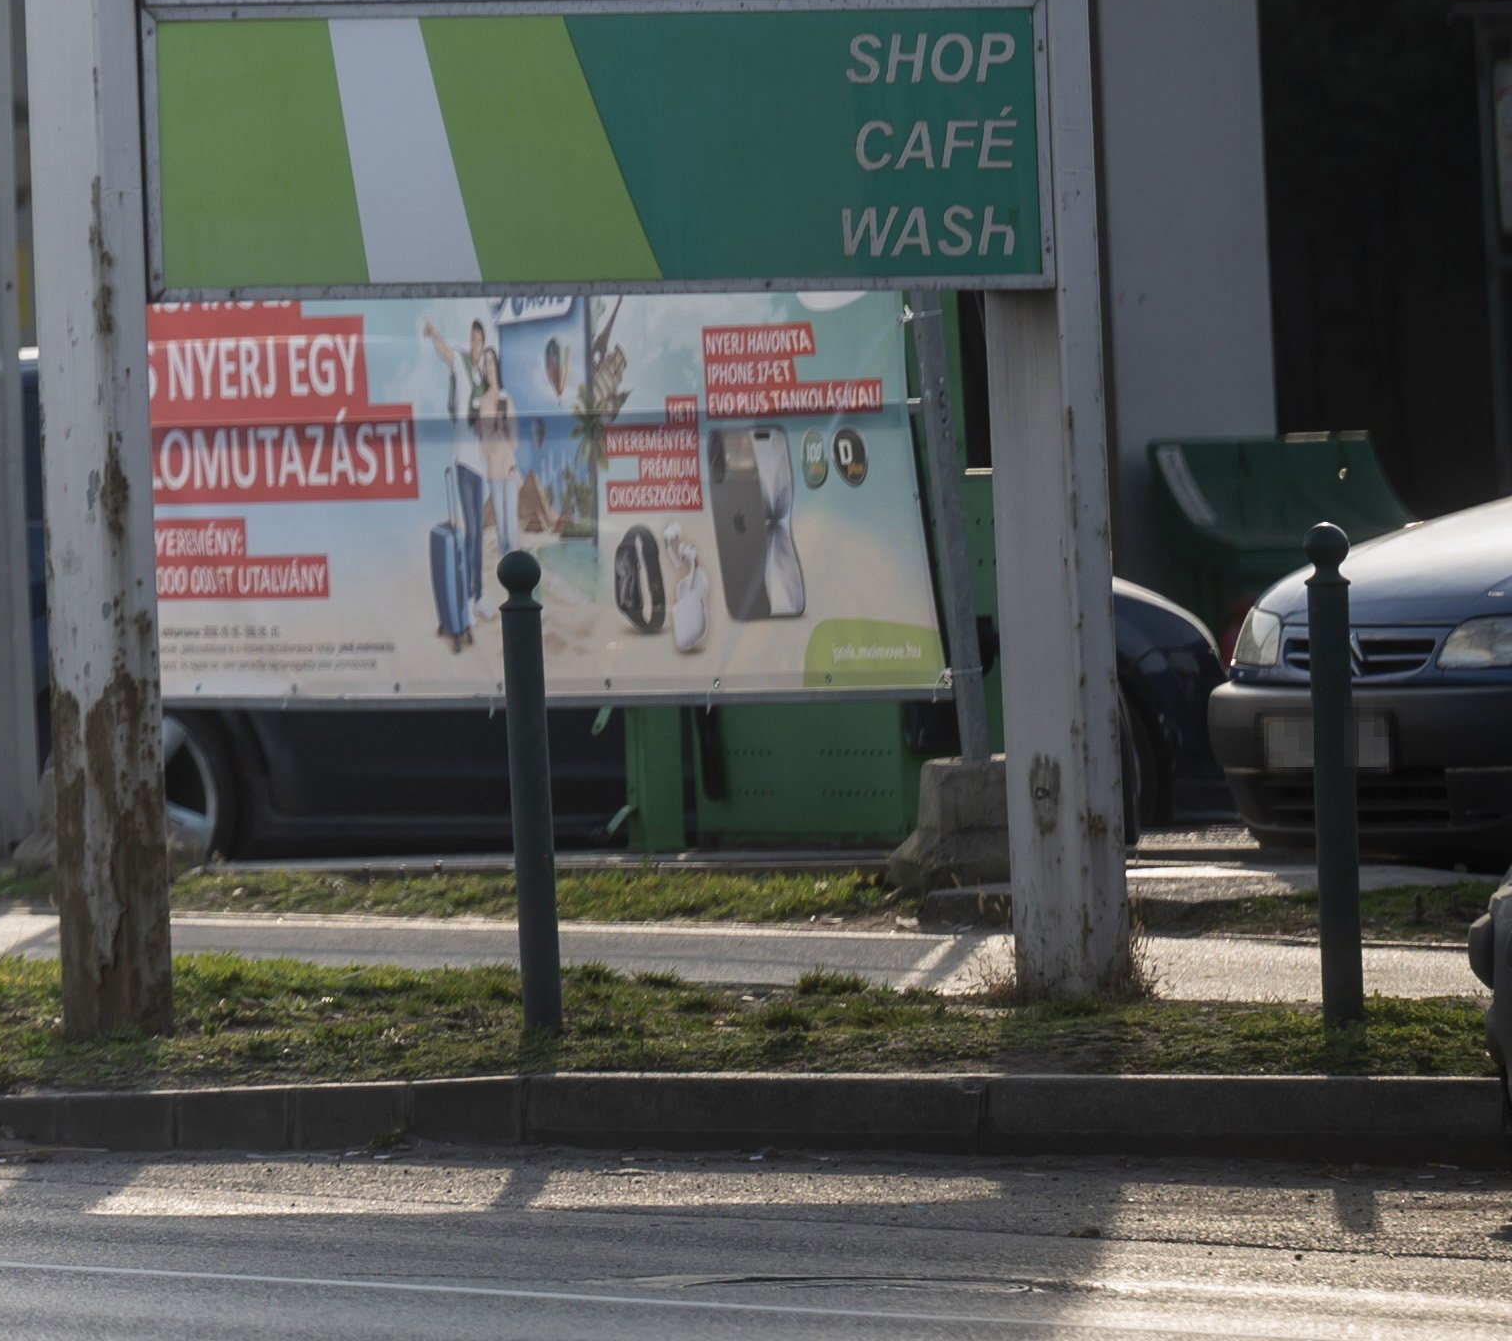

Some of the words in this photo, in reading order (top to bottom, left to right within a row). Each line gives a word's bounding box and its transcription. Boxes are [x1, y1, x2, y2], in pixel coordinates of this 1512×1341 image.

[845, 33, 1016, 84] SHOP
[855, 106, 1017, 171] CAFÉ
[705, 331, 744, 356] NYERJ
[747, 329, 811, 354] HAVONTA
[166, 336, 277, 401] NYERJ
[287, 333, 358, 397] EGY
[707, 361, 754, 386] IPHONE
[757, 359, 791, 384] 17-ET
[736, 389, 769, 414] PLUS
[606, 426, 696, 452] NYEREMÉNYEK:
[838, 438, 853, 466] D
[641, 456, 697, 479] PRÉMIUM
[237, 557, 326, 595] UTALVÁNY
